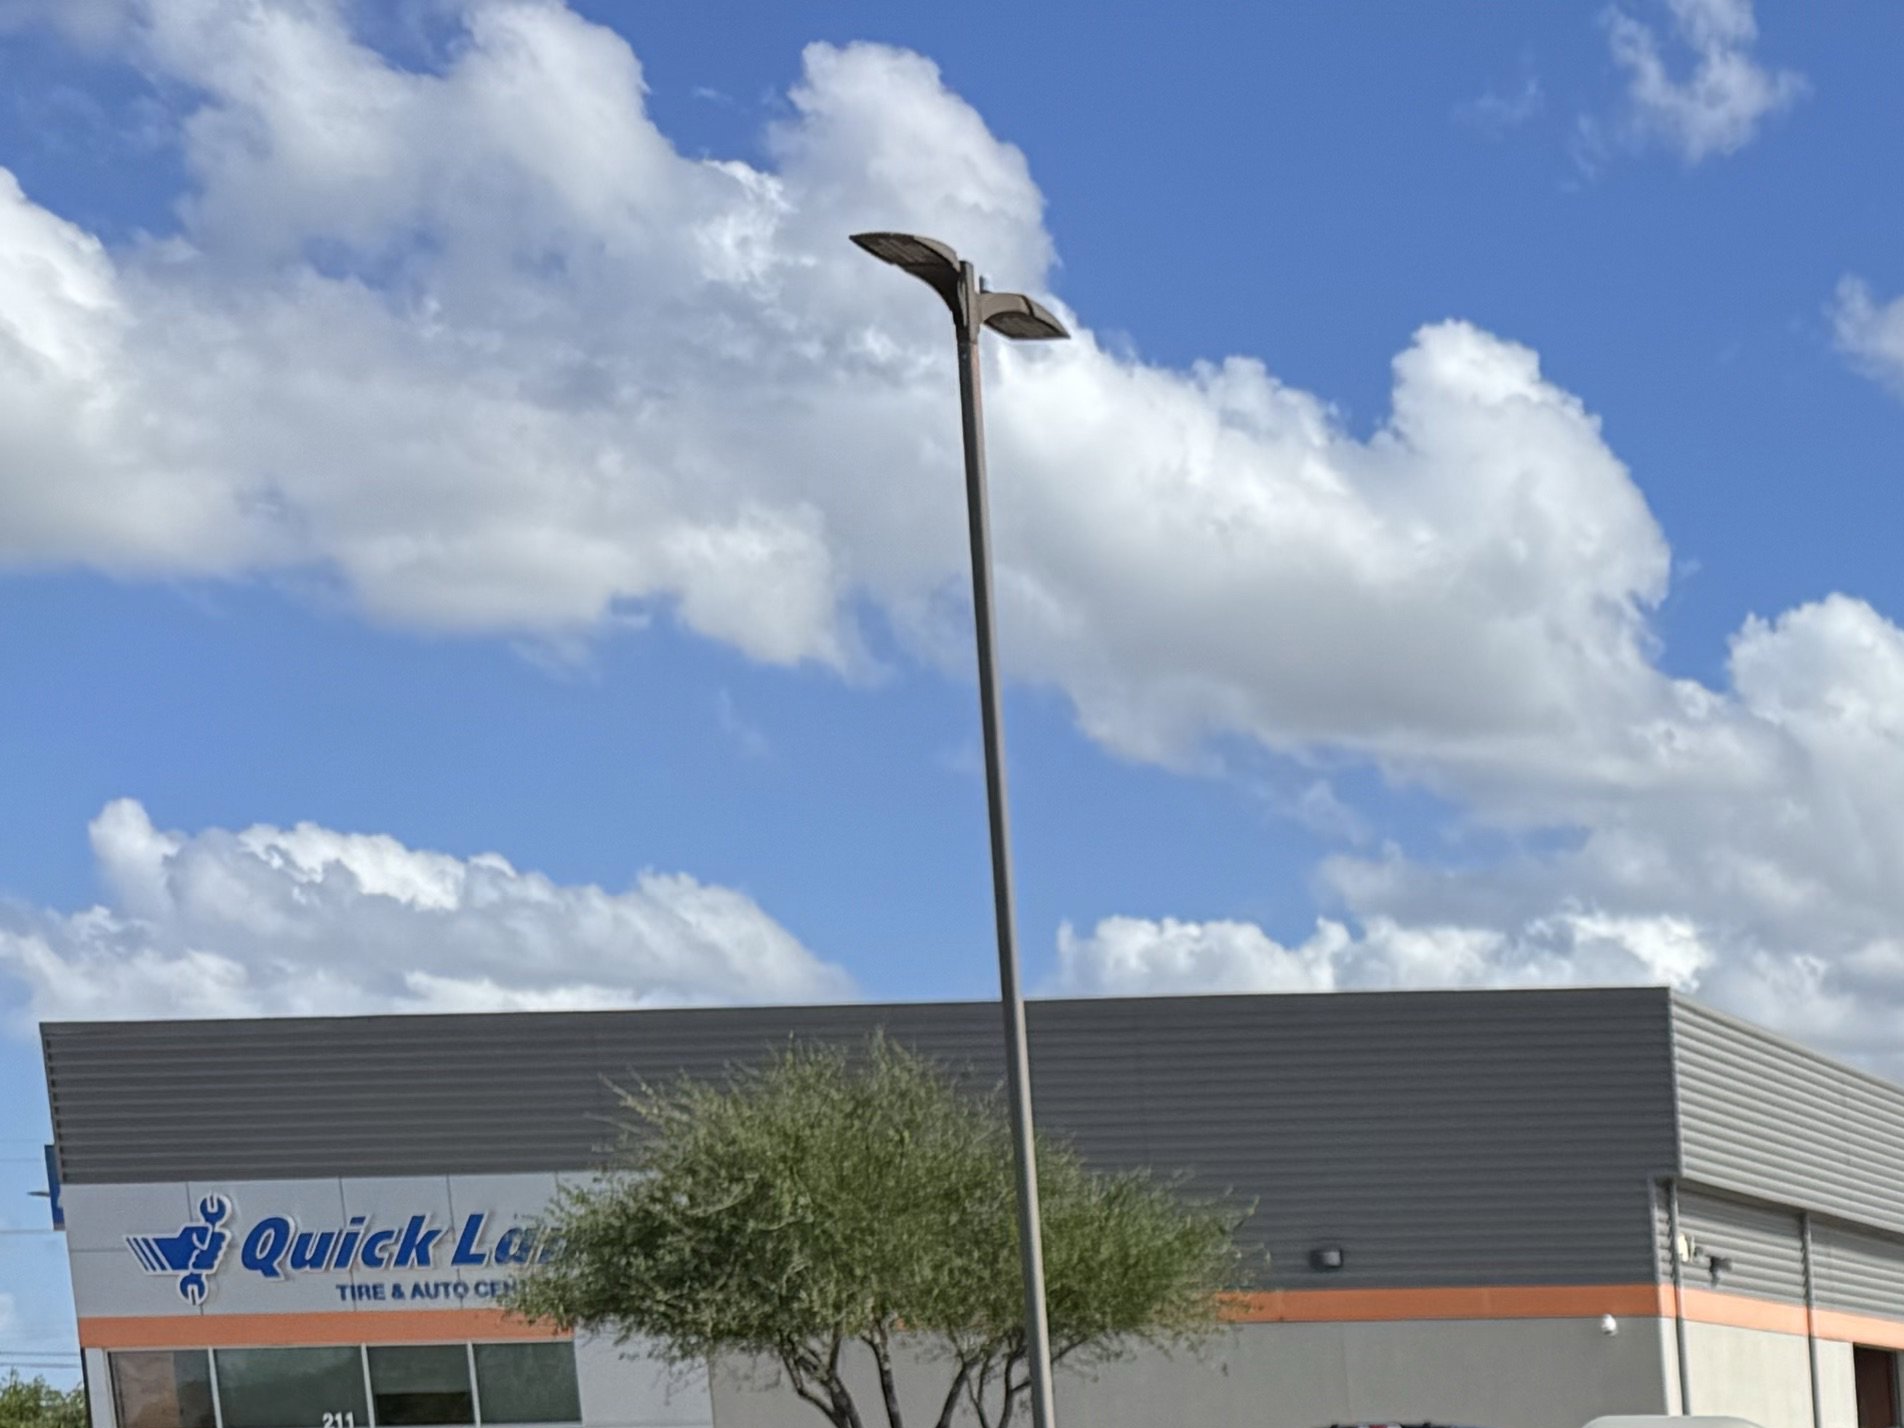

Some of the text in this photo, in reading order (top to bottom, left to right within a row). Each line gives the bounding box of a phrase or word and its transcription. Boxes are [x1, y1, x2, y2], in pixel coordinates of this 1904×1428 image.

[241, 1213, 567, 1278] Quick Lan
[336, 1283, 385, 1301] TIRE
[391, 1283, 404, 1299] &
[410, 1281, 470, 1299] AUTO
